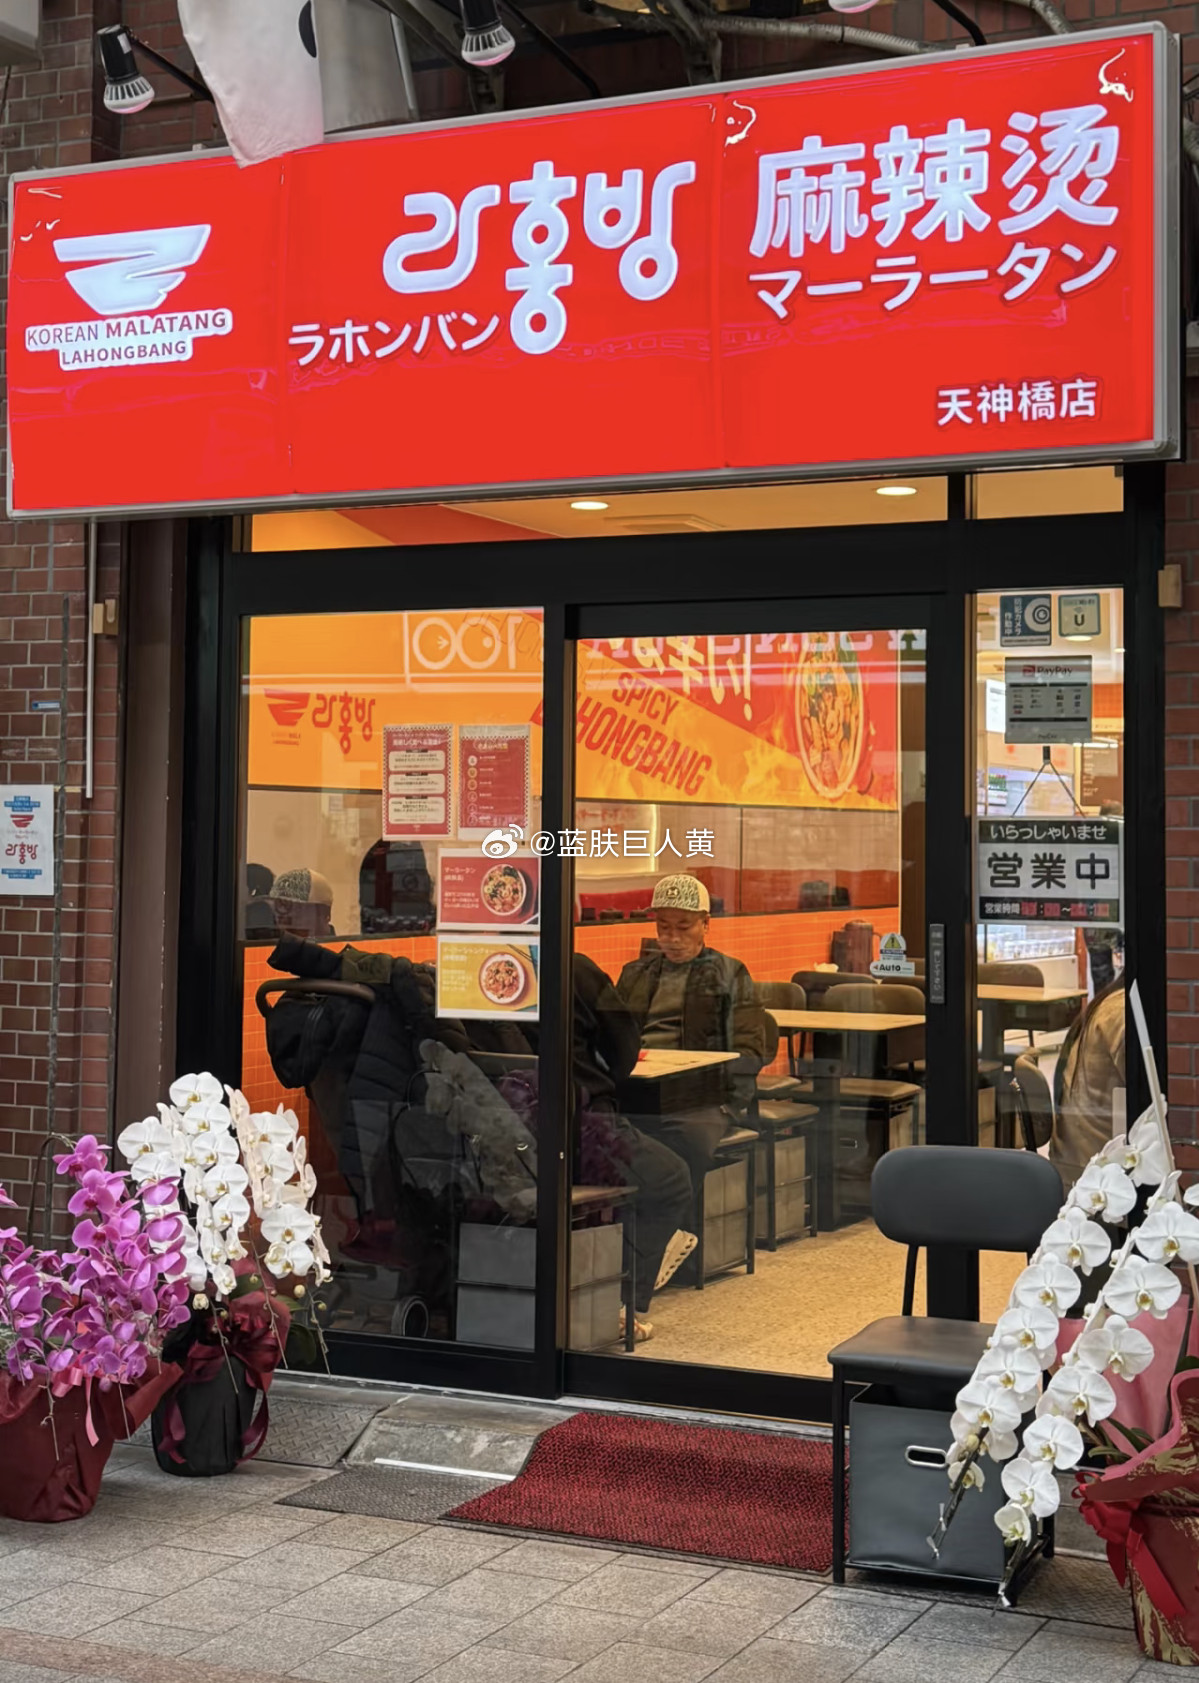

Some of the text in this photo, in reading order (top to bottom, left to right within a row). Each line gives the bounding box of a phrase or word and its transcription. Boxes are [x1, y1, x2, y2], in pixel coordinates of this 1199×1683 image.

[749, 104, 1120, 258] 麻辣烫
[383, 161, 696, 354] 라홍방
[749, 242, 1117, 319] マーラータン
[27, 311, 226, 346] KOREAN MALATANG
[289, 311, 500, 366] ラホンバン
[62, 341, 186, 365] LAHONGBANG
[937, 378, 1097, 426] 天神橋店
[1036, 665, 1073, 676] PayPay
[312, 691, 375, 755] 라홍방
[612, 672, 680, 726] SPICY
[574, 693, 713, 797] HONGBANG
[5, 842, 38, 864] 라홍방
[990, 825, 1107, 840] いらっしゃいませ
[987, 852, 1110, 890] 営業中
[879, 964, 901, 972] Auto
